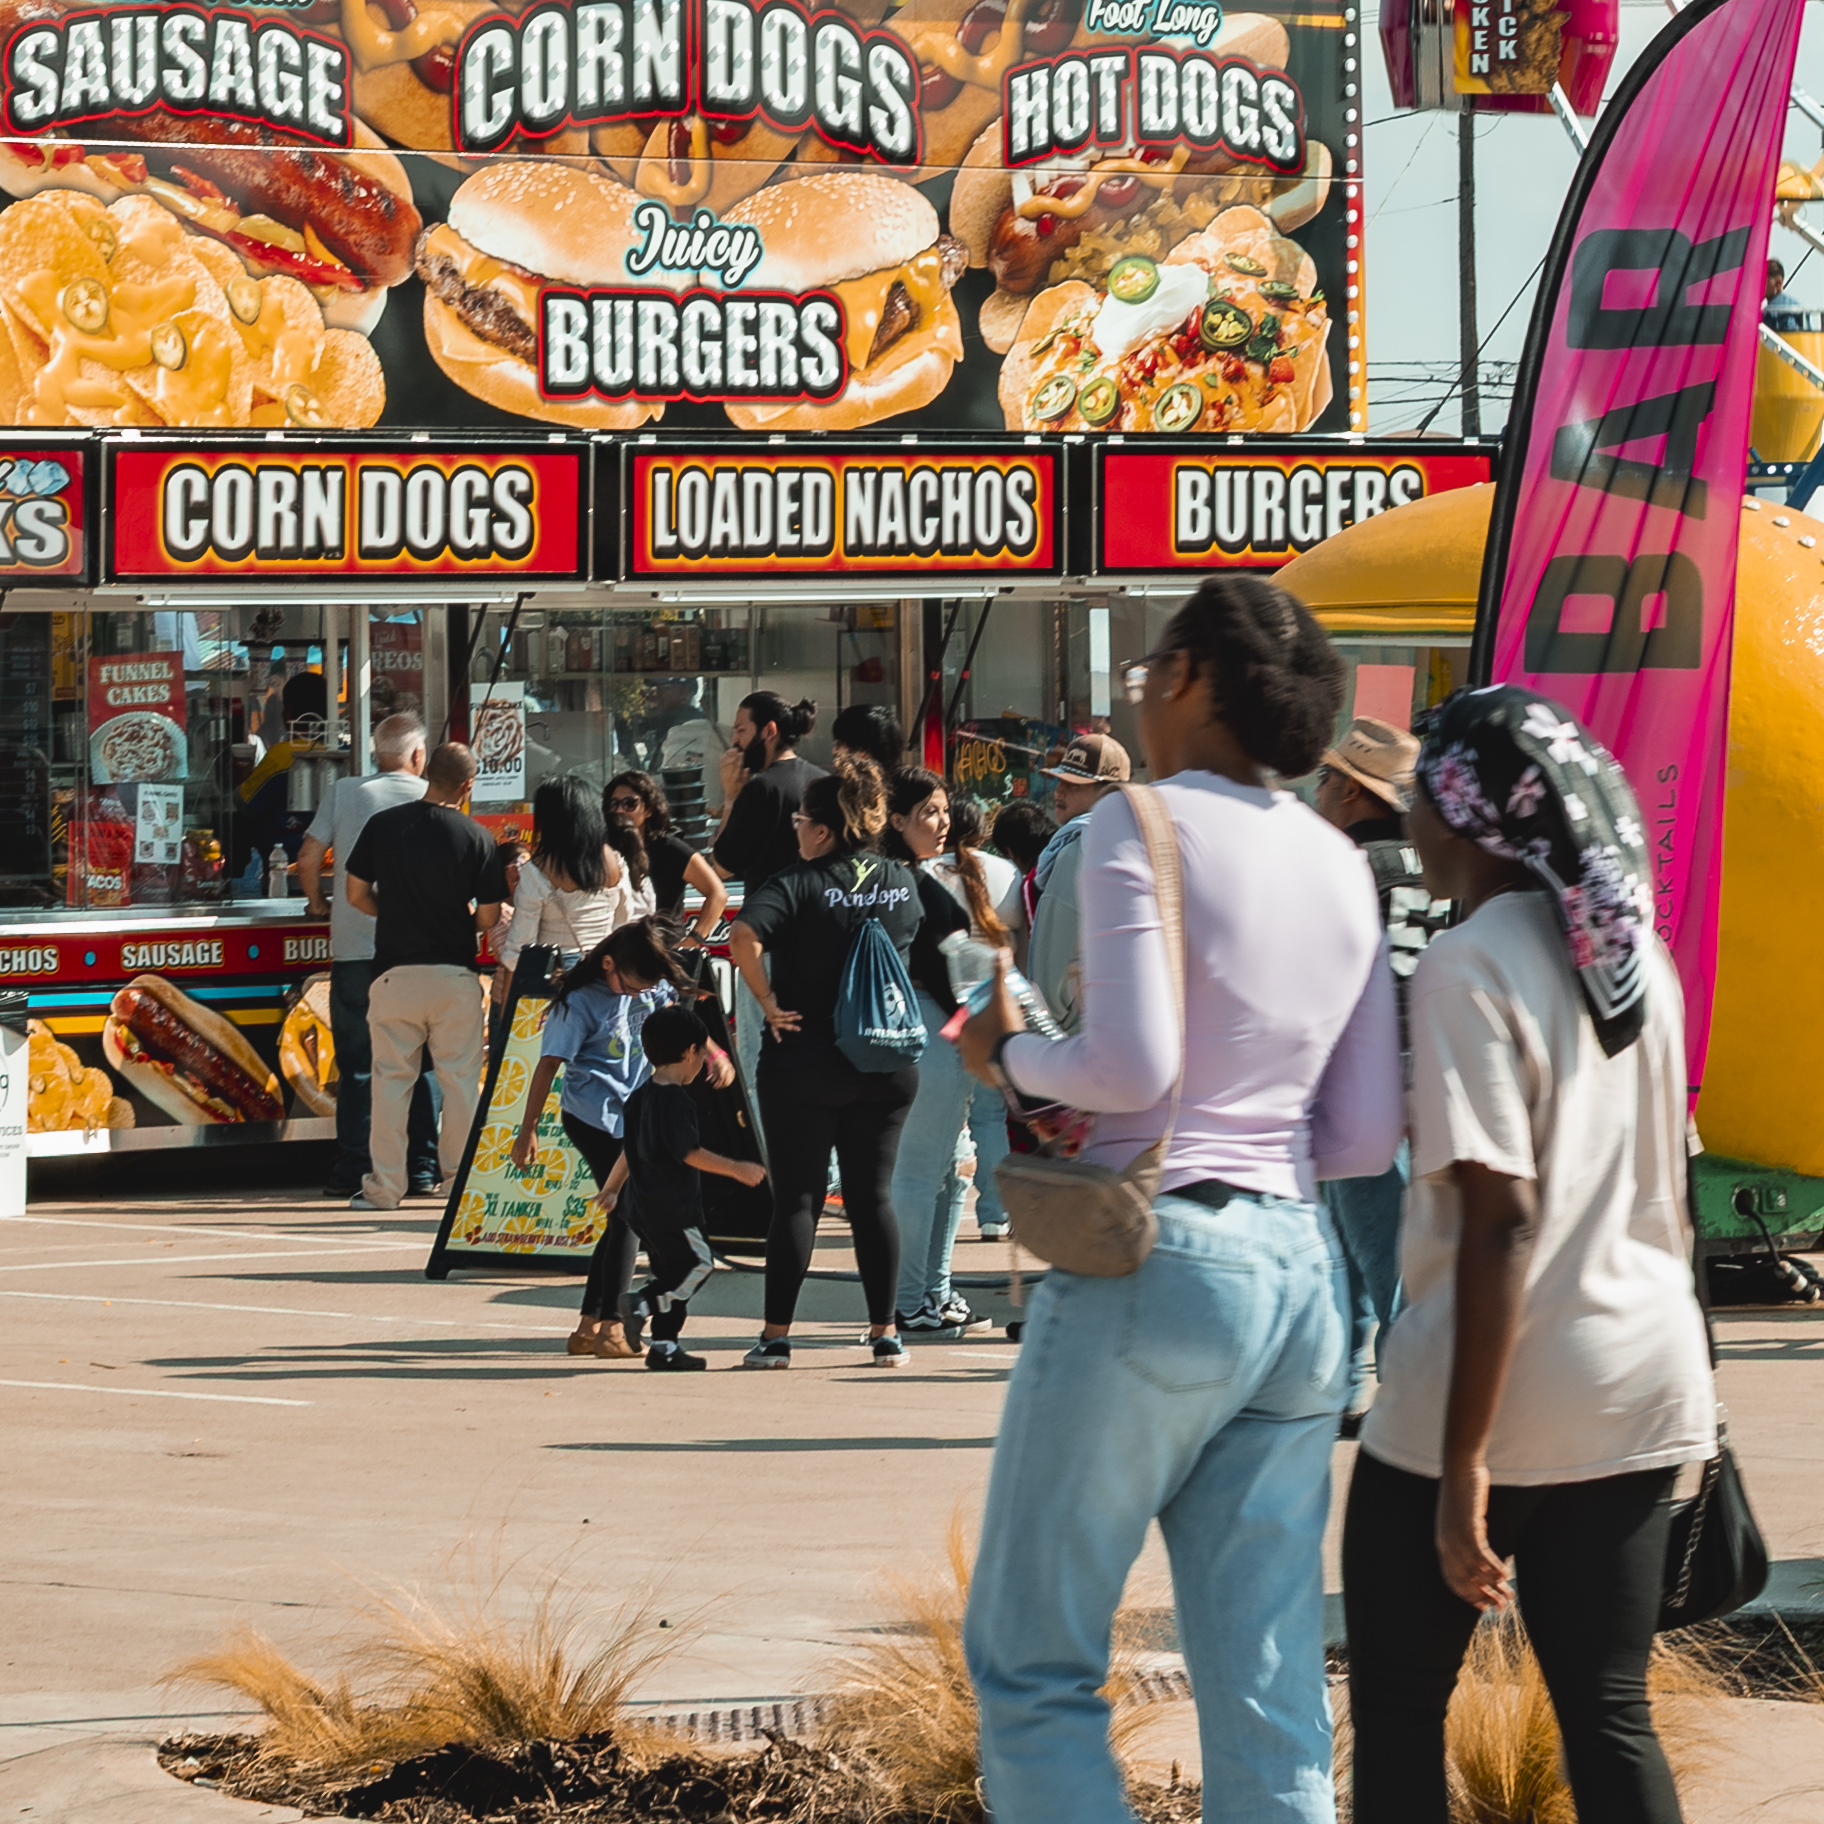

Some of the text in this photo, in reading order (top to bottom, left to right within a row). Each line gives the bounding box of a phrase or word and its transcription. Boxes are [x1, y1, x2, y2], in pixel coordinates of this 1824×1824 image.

[13, 10, 346, 144] SAUSAGE
[706, 0, 917, 159] DOGS
[1008, 52, 1297, 166] HOT DOGS
[630, 206, 760, 281] Juicy
[546, 298, 841, 389] BURGERS
[1525, 227, 1751, 674] BAR
[165, 469, 533, 559] CORN DOGS
[652, 469, 1036, 557] LOADED NACHOS
[100, 662, 174, 683] FUNNEL
[107, 684, 170, 705] CAKES
[824, 884, 910, 911] Penelope
[1656, 763, 1679, 960] OCKTAILS
[122, 939, 224, 970] SAUSAGE
[284, 938, 331, 962] BUR
[562, 1194, 589, 1218] $35
